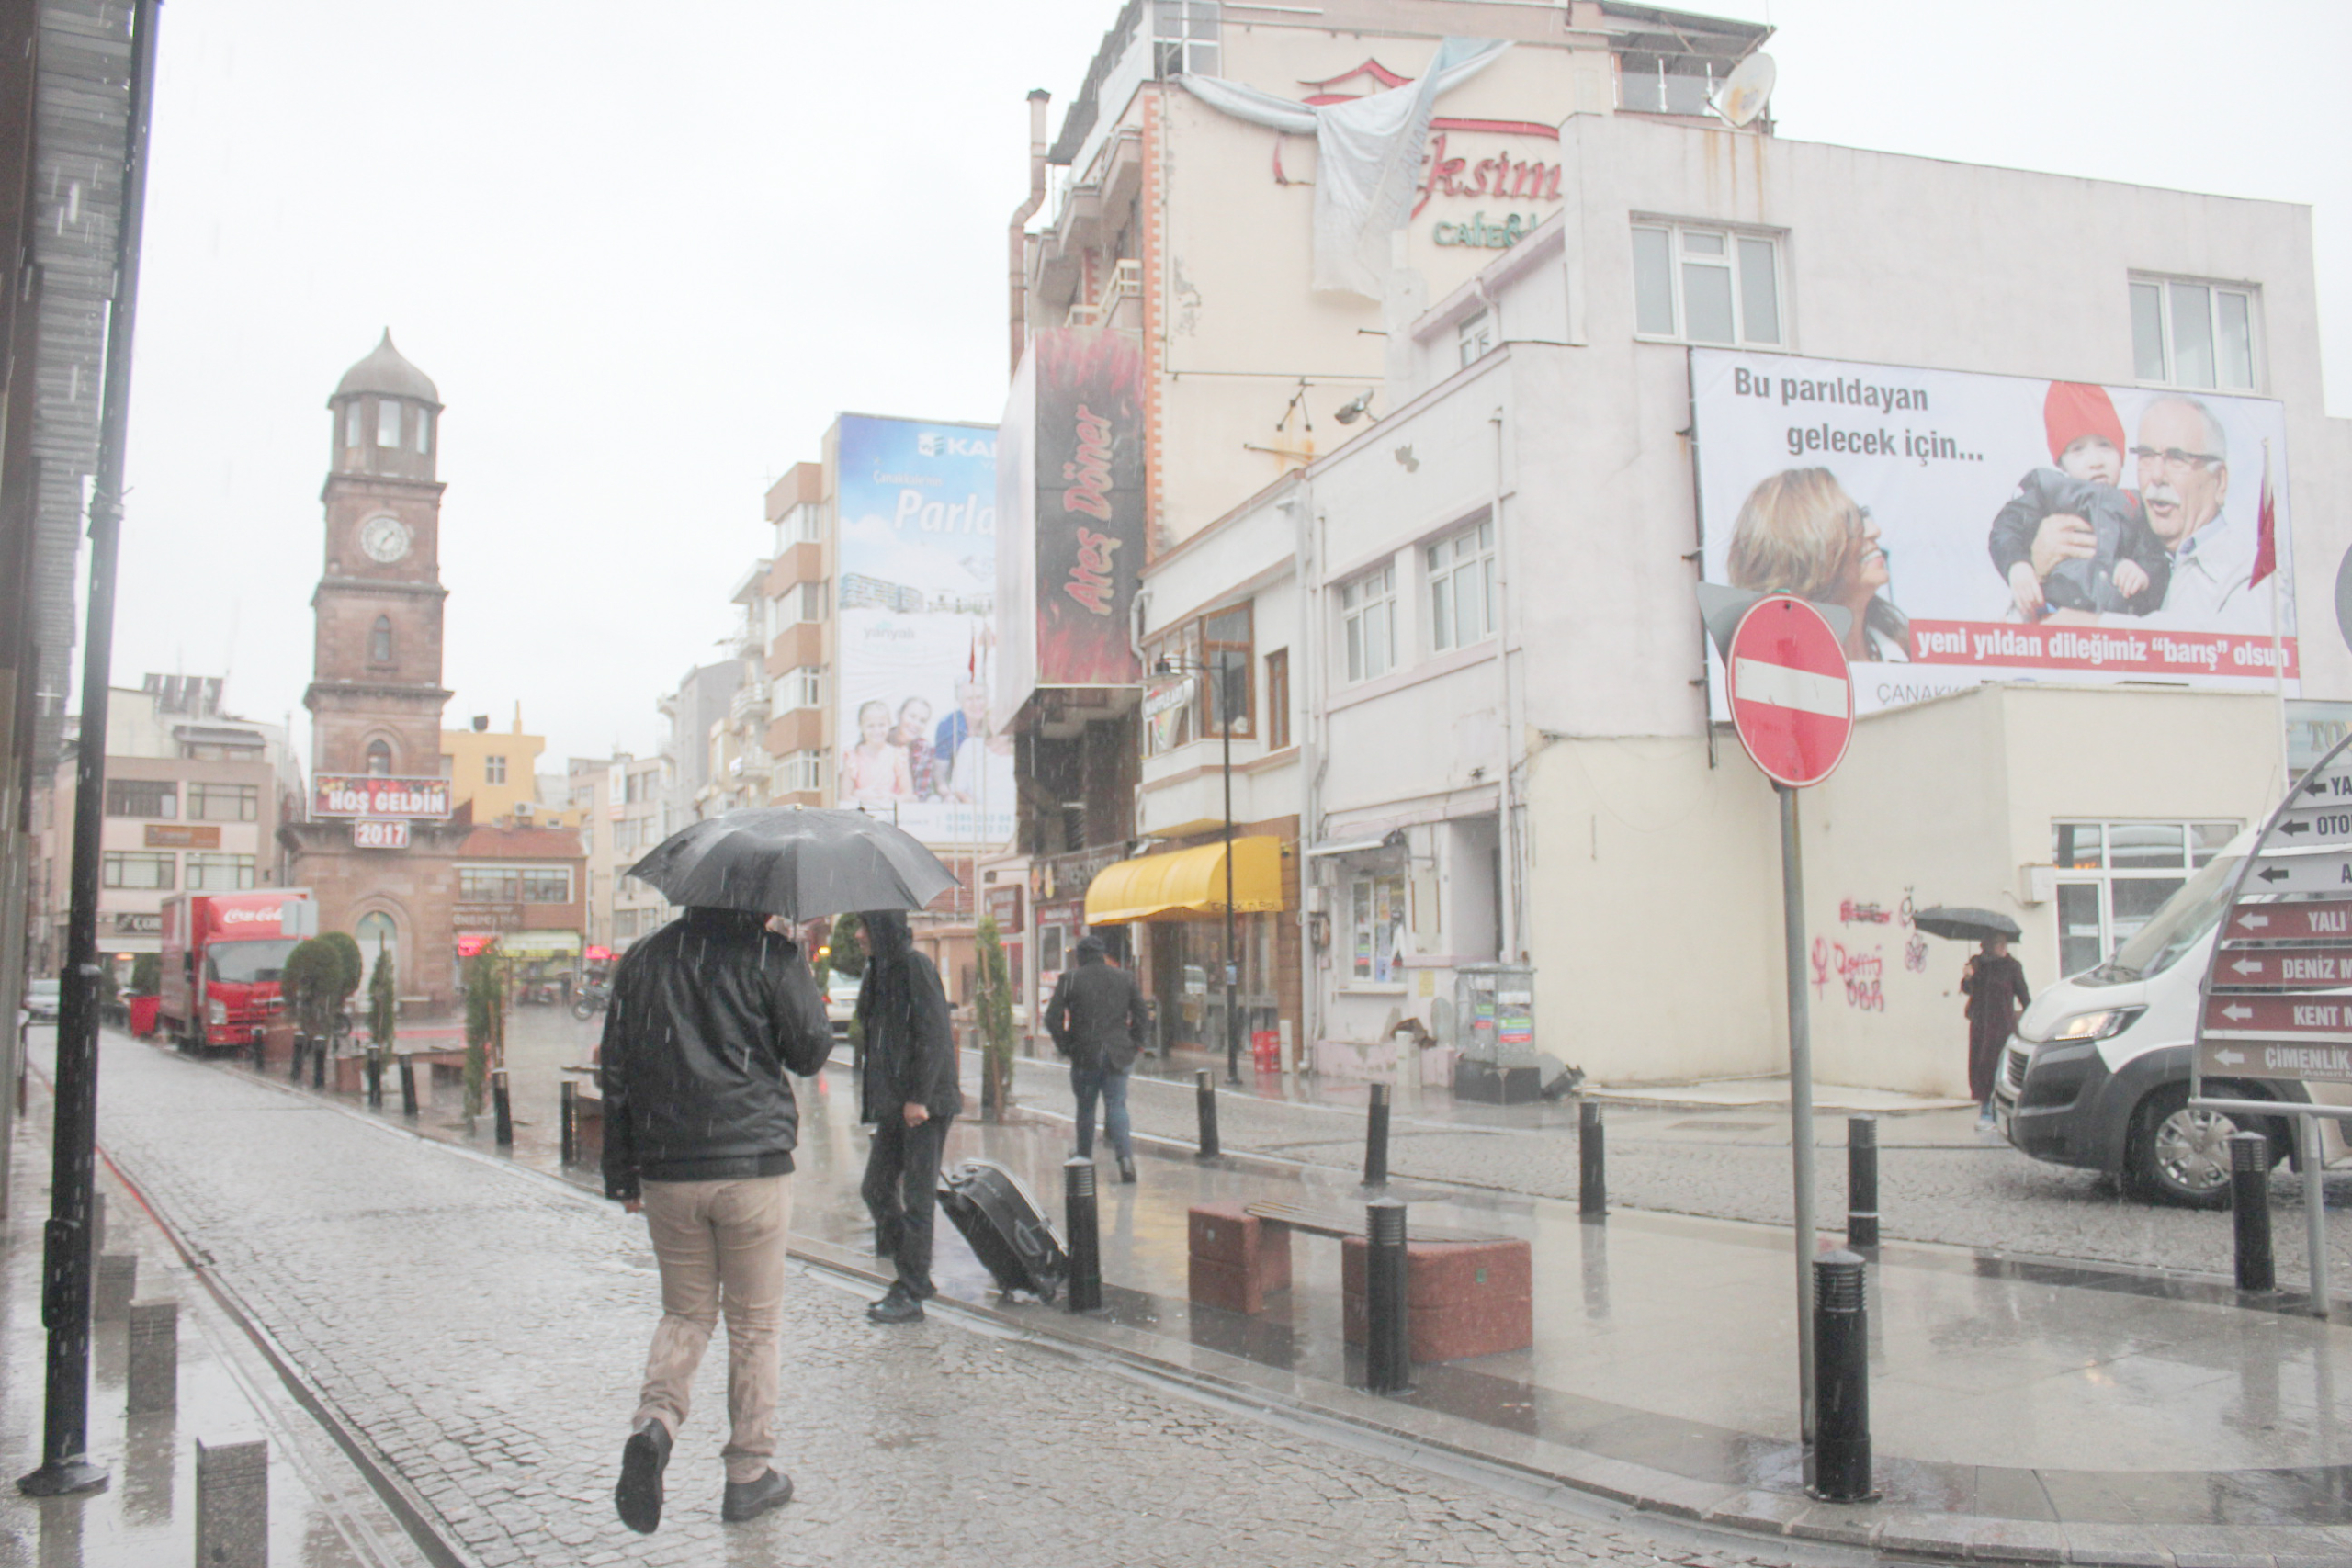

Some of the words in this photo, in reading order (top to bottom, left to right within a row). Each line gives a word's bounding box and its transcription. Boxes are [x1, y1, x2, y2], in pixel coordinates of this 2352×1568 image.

[1734, 367, 1771, 398] Bu
[1781, 377, 1928, 414] parıldayan
[1787, 423, 1897, 457] gelecek
[1905, 428, 1984, 467] için...
[1062, 403, 1114, 522] Döner
[1063, 526, 1123, 617] Ateş
[1916, 627, 1967, 659] yeni
[1973, 628, 2042, 660] yıldan
[2048, 631, 2148, 666] dileğimiz
[2151, 637, 2229, 671] “barış”
[2233, 641, 2290, 668] olsun
[328, 789, 371, 818] HOŞ
[374, 786, 447, 814] GELDİN
[357, 823, 406, 844] 2017
[2307, 911, 2346, 932] YALI
[2281, 955, 2335, 979] DENİZ
[2293, 1005, 2338, 1026] KENT
[2265, 1044, 2350, 1071] ÇİMENLİK
